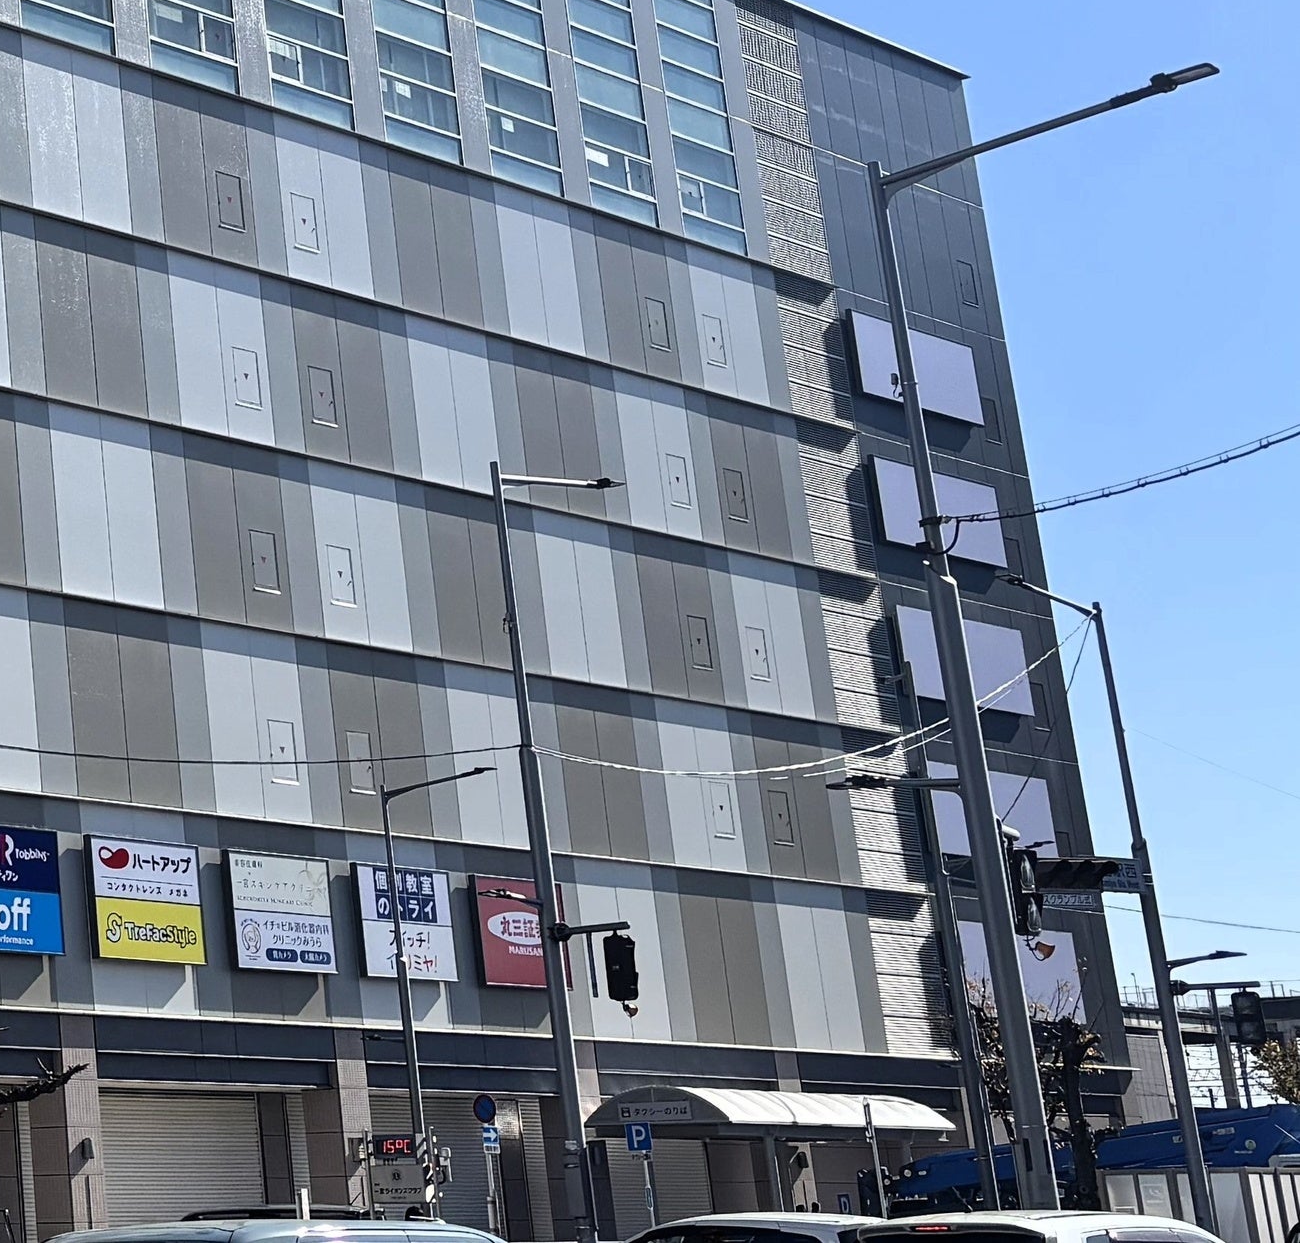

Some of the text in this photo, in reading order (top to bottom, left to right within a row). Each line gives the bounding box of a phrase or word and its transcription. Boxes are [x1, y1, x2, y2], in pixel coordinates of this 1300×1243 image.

[15, 848, 48, 862] robbins
[132, 853, 192, 874] ハートアップ
[107, 882, 162, 895] コンタクトレンズ
[378, 897, 434, 920] のライ
[124, 921, 198, 949] TreFacStyle
[634, 1106, 688, 1117] タクシーのりば
[631, 1125, 646, 1149] P
